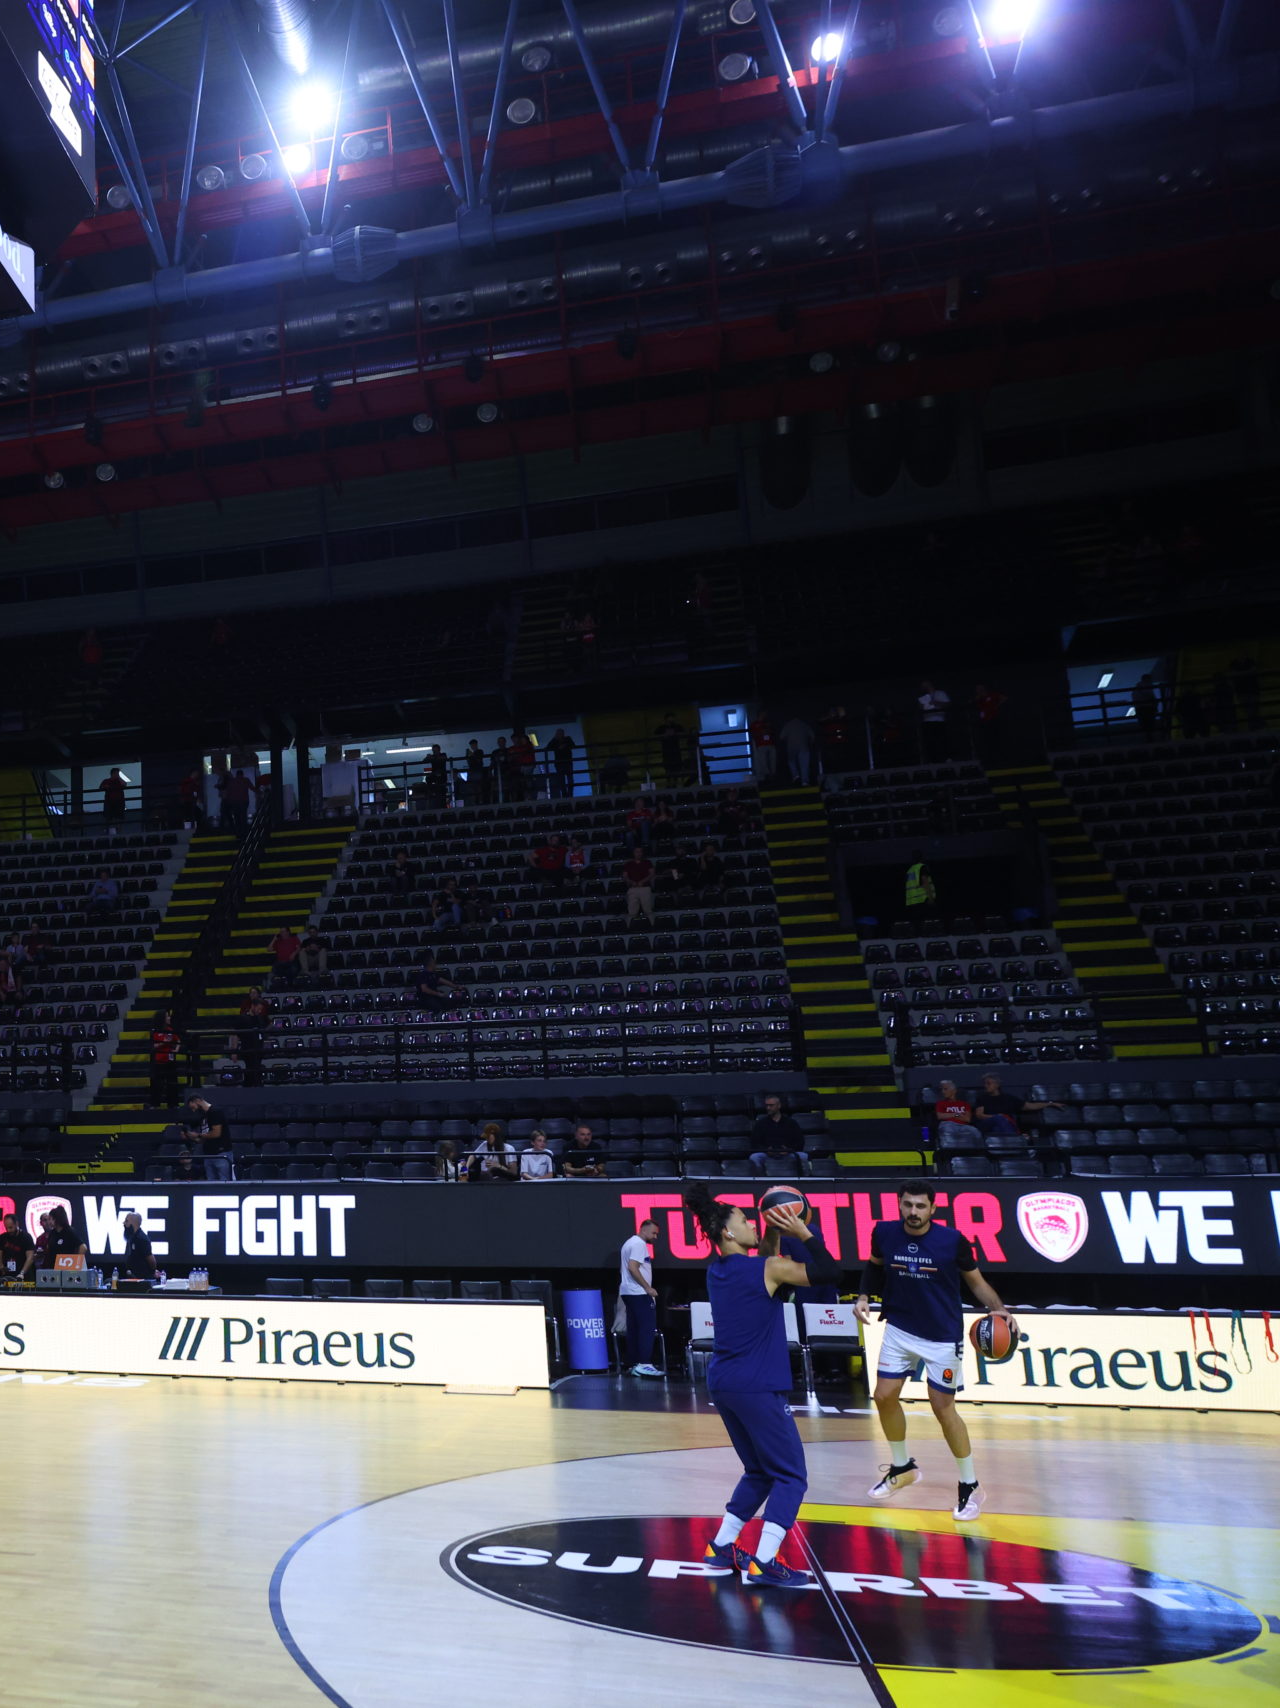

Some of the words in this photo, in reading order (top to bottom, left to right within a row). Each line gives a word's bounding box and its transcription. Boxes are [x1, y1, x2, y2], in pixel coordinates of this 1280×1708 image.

[83, 1195, 169, 1255] WE
[192, 1195, 356, 1257] FIGHT
[1101, 1190, 1244, 1265] WE
[220, 1317, 416, 1369] Piraeus
[567, 1318, 604, 1329] POWER
[584, 1328, 605, 1339] ADE
